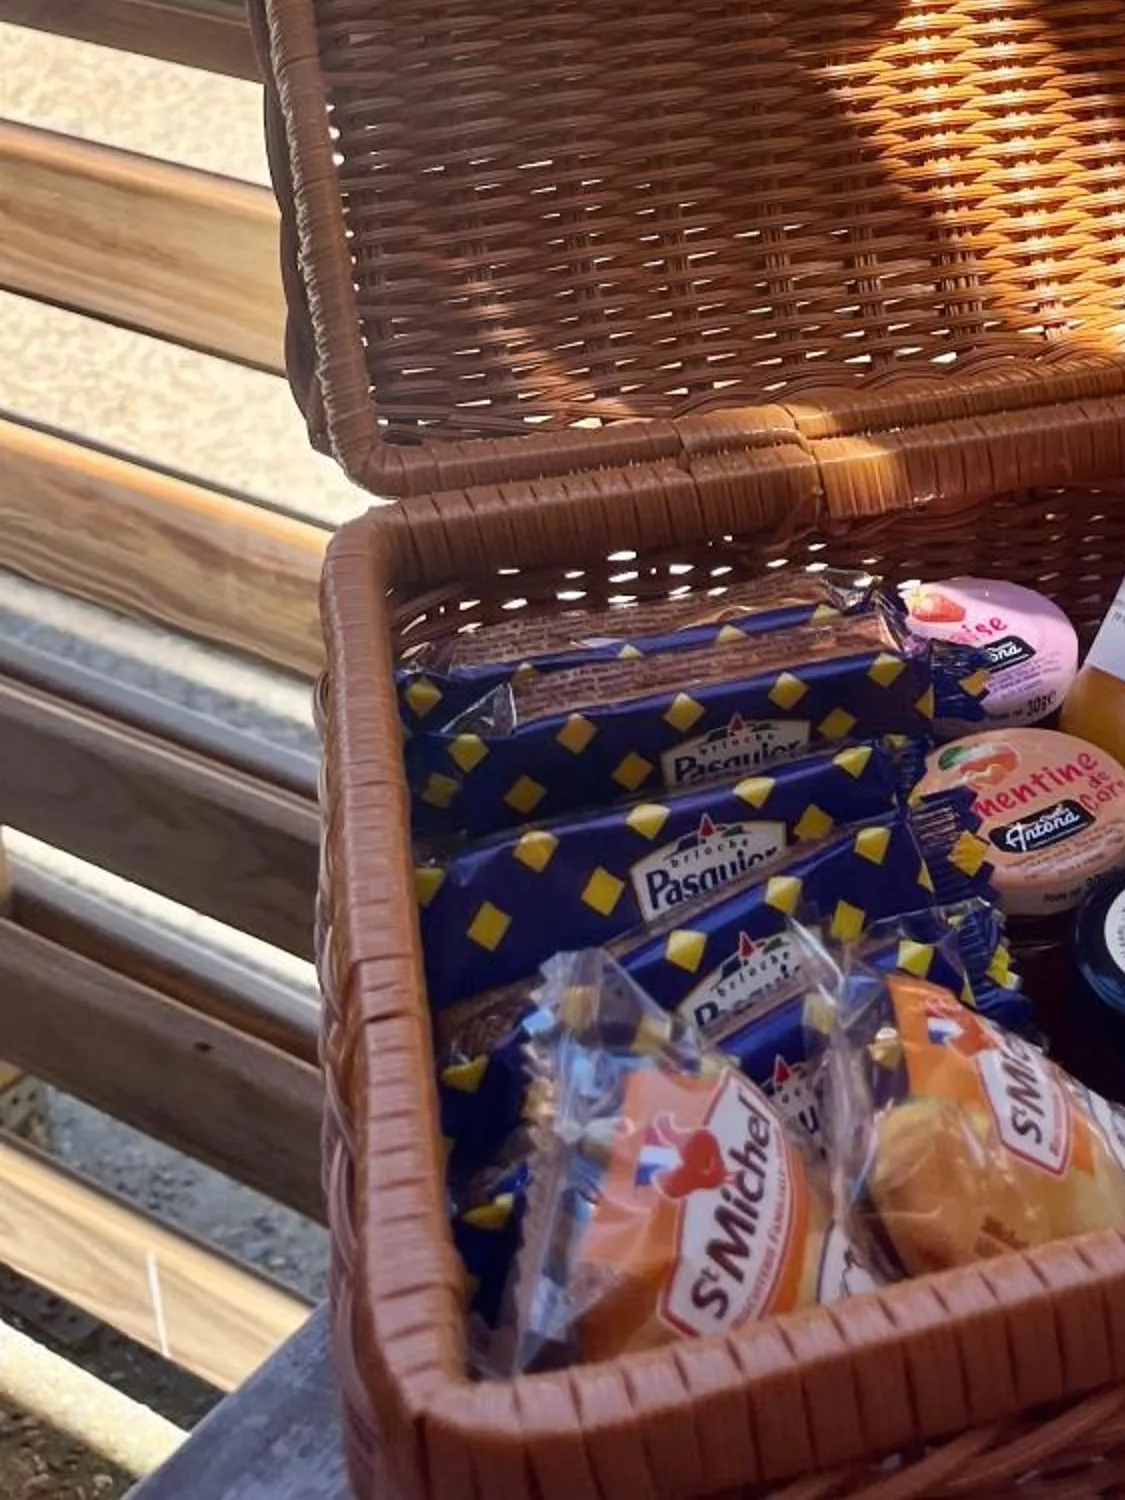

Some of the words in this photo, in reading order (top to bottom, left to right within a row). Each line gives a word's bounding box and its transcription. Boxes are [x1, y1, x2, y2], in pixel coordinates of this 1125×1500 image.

[701, 732, 774, 755] brioche
[973, 753, 1097, 816] mentine
[1005, 810, 1080, 851] Antona
[671, 839, 747, 868] brioche
[718, 952, 789, 996] brioche
[706, 1092, 771, 1285] Michel
[691, 1266, 729, 1320] St
